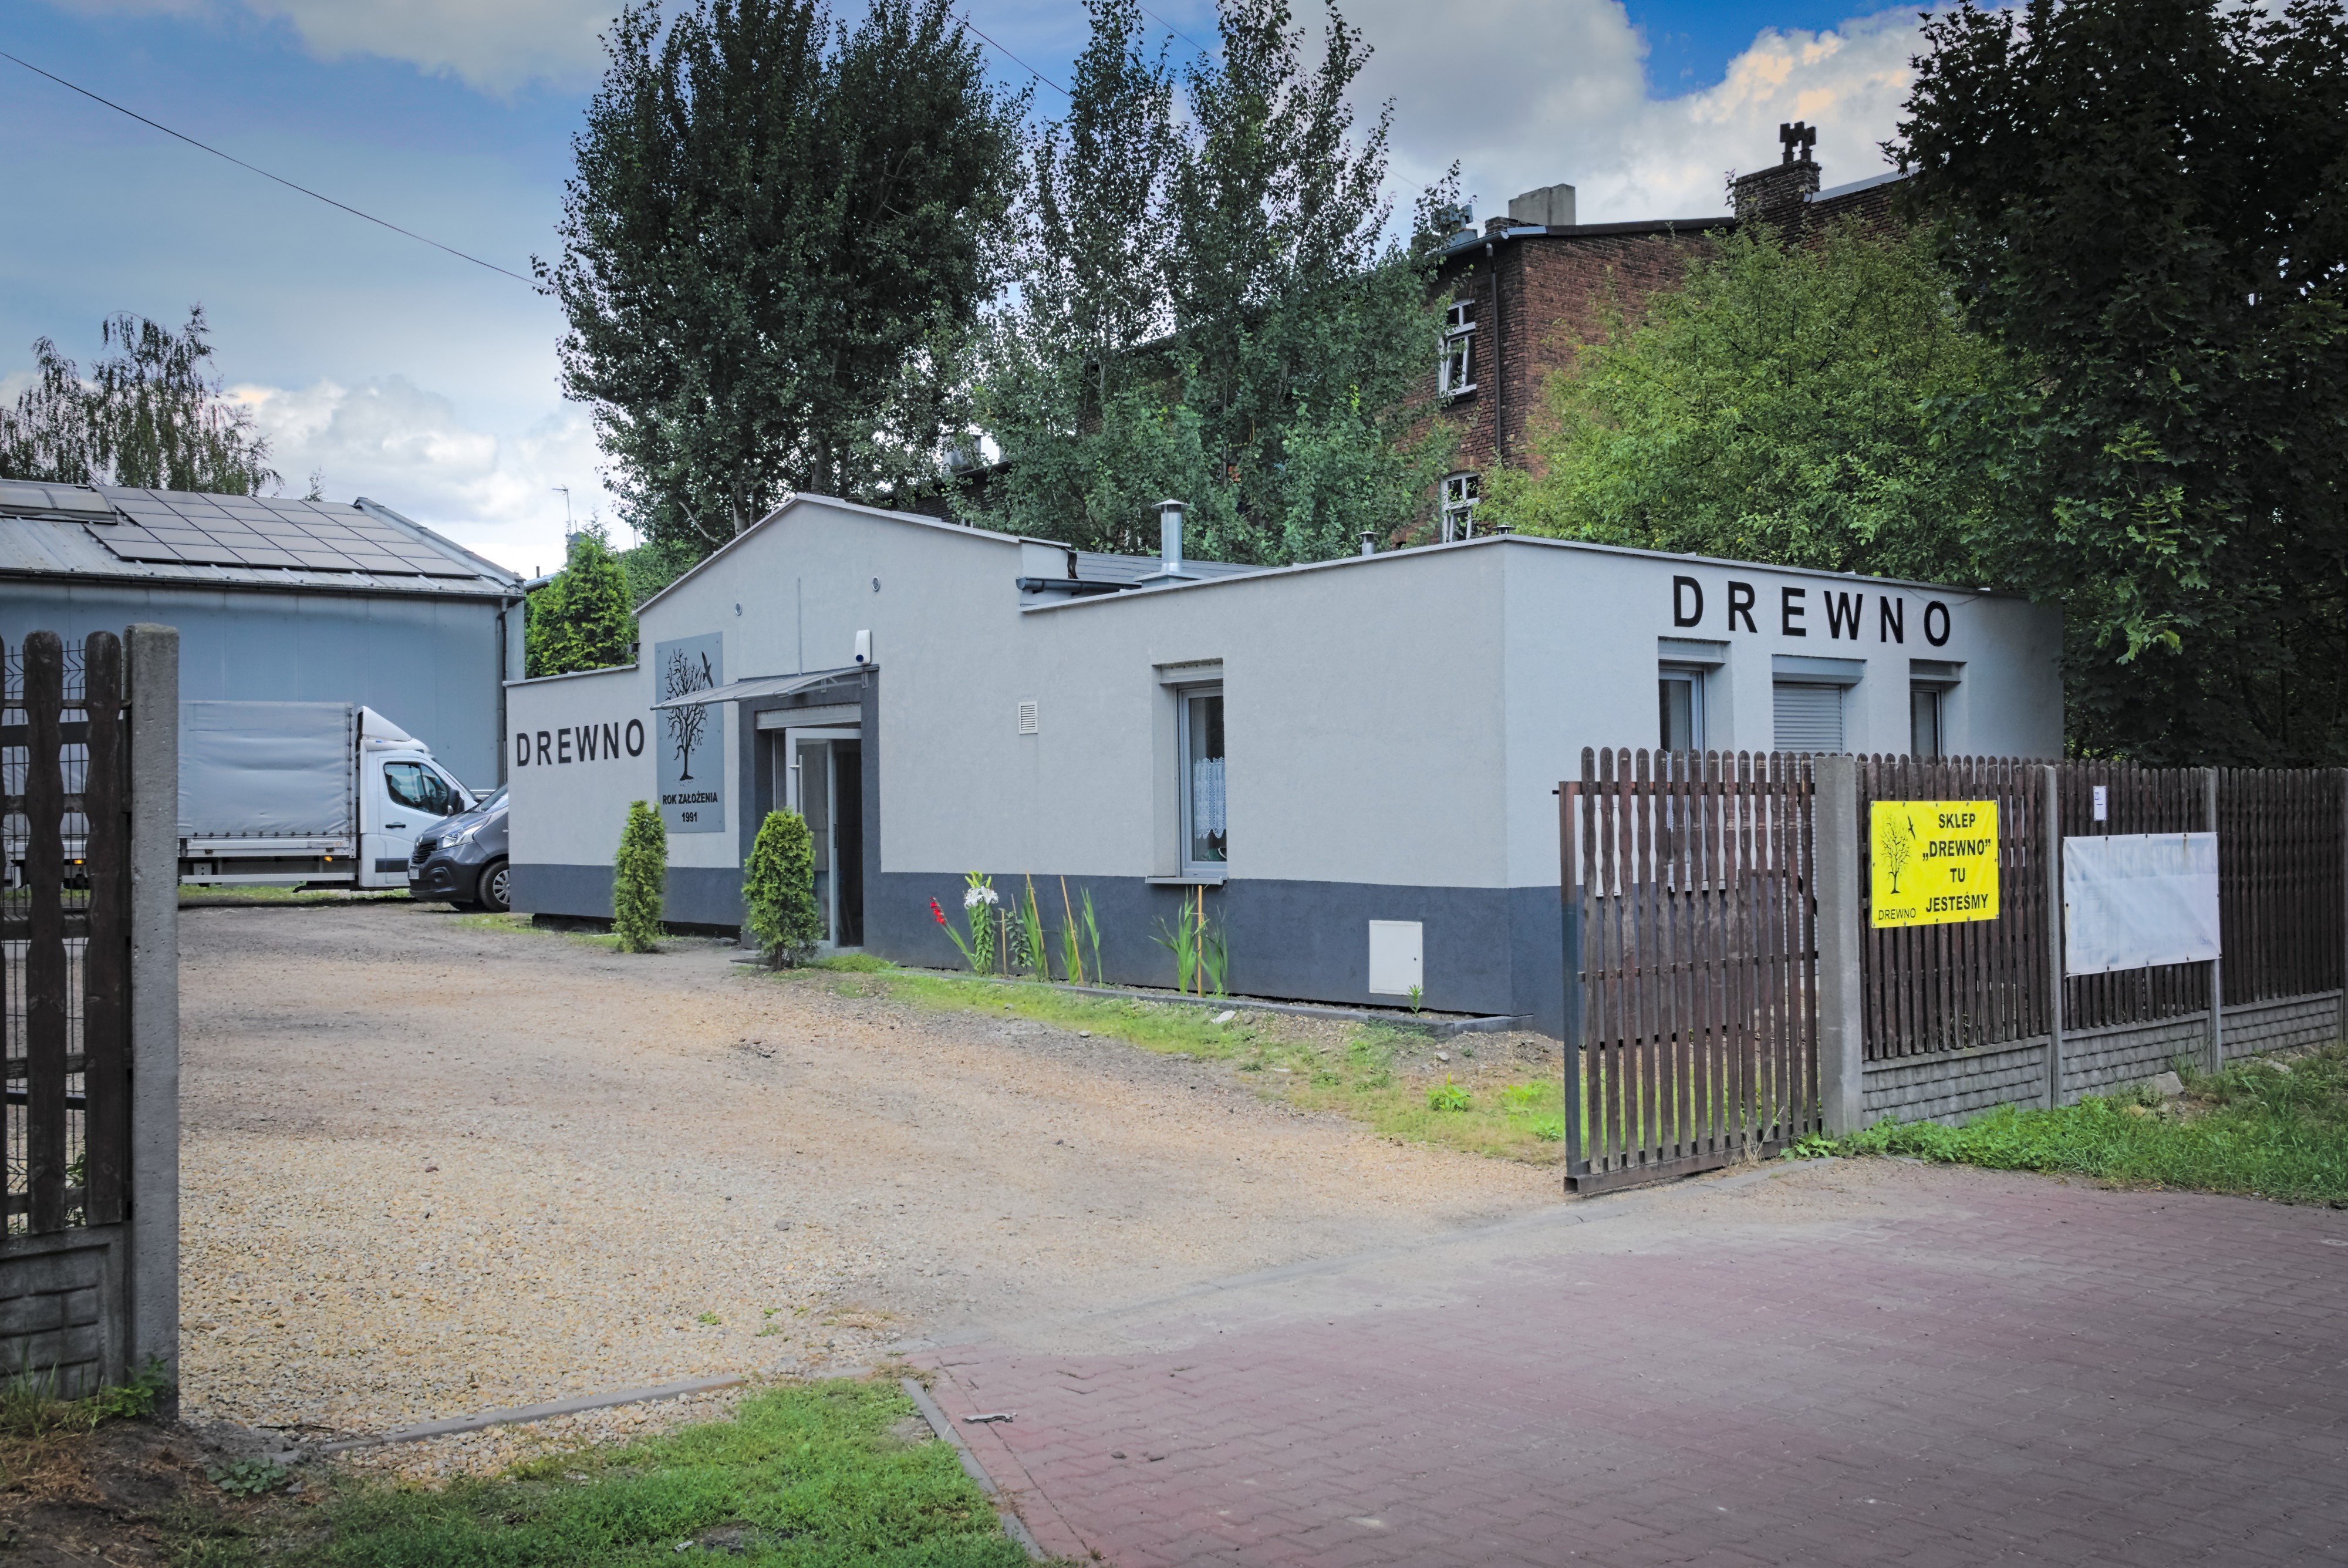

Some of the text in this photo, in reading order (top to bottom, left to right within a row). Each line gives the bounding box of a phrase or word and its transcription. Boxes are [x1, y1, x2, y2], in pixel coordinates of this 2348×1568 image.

[1672, 574, 1951, 647] DREWNO
[517, 719, 645, 767] DREWNO
[662, 790, 718, 805] ROK ZAŁOŻENIA
[682, 811, 697, 822] 1991
[1938, 813, 1975, 829] SKLEP
[1922, 838, 1991, 861] „DREWNO”
[1949, 867, 1965, 883] TU
[1925, 892, 1989, 913] JESTEŚMY
[1878, 908, 1916, 920] DREWNO
